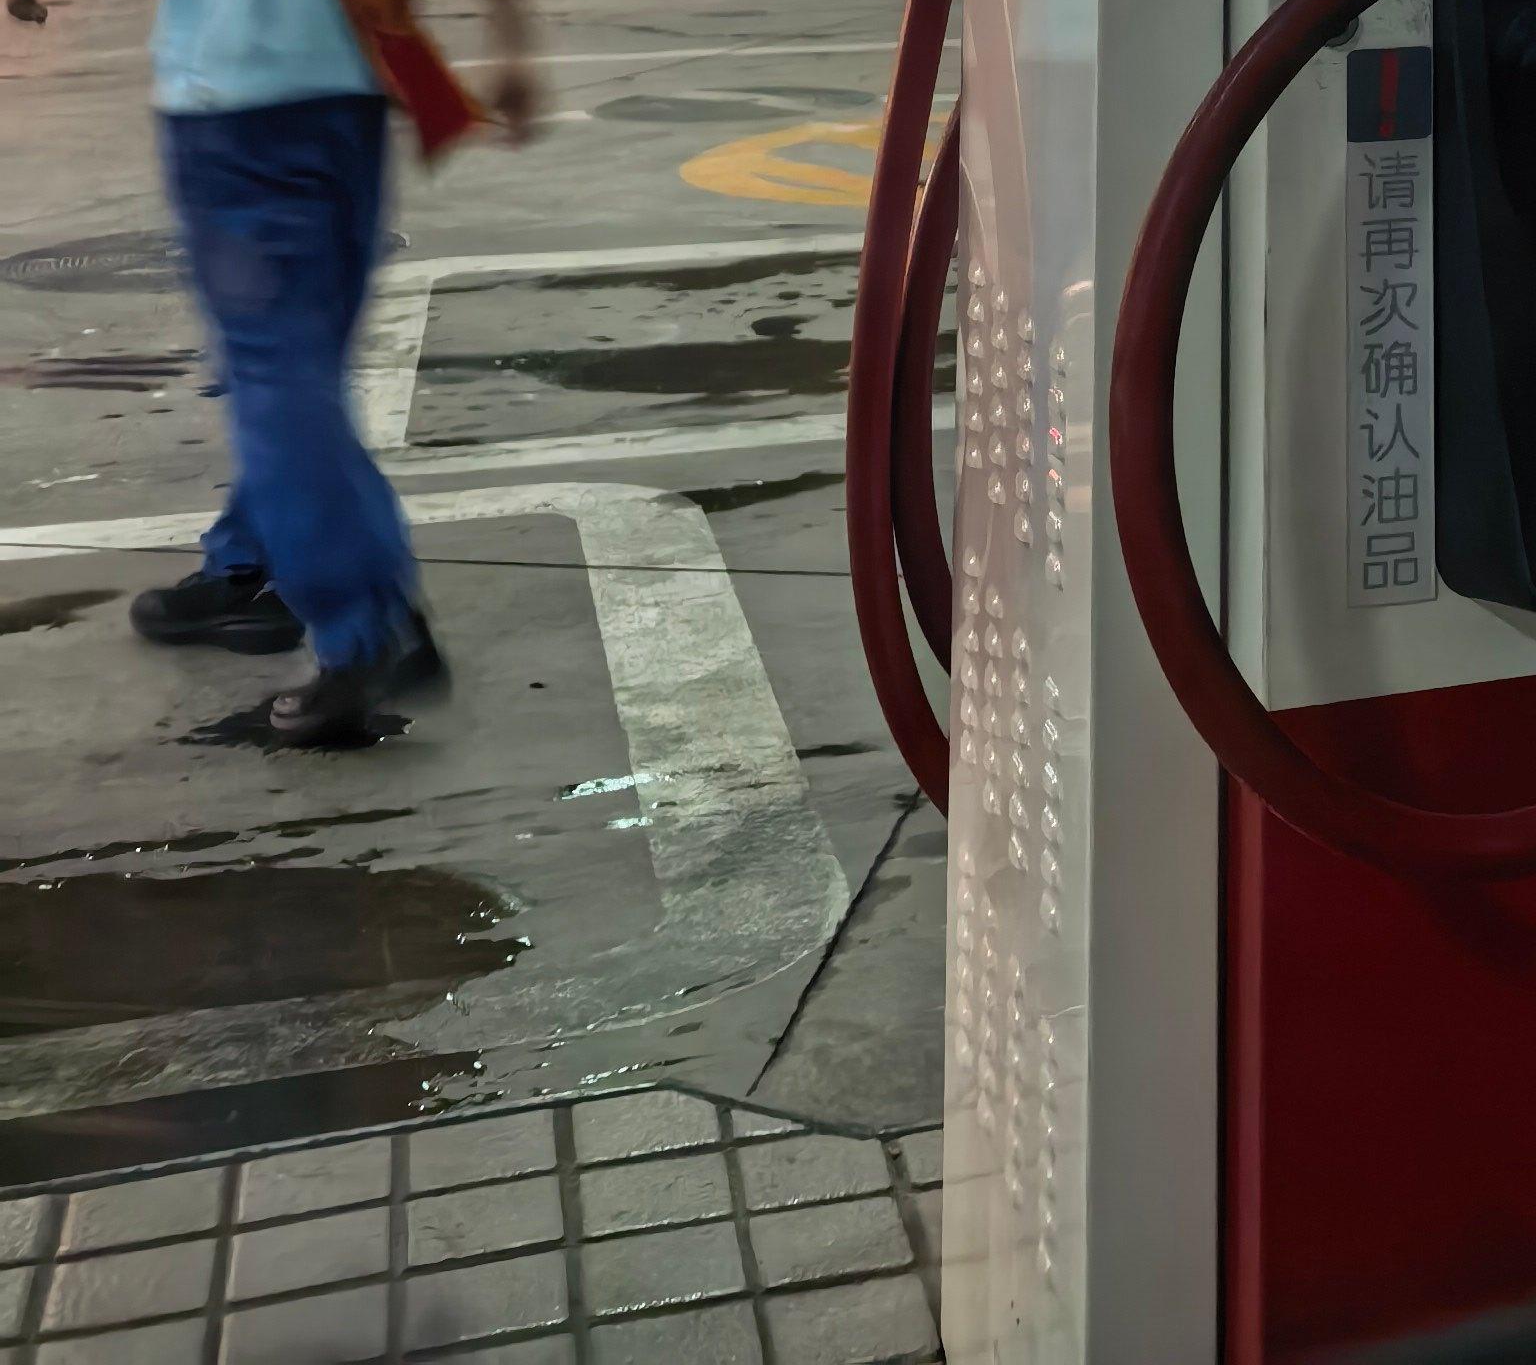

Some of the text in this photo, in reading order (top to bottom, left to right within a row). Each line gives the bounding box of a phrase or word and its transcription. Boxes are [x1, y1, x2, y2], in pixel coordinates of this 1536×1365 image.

[1359, 151, 1420, 590] 请再次确认油品
